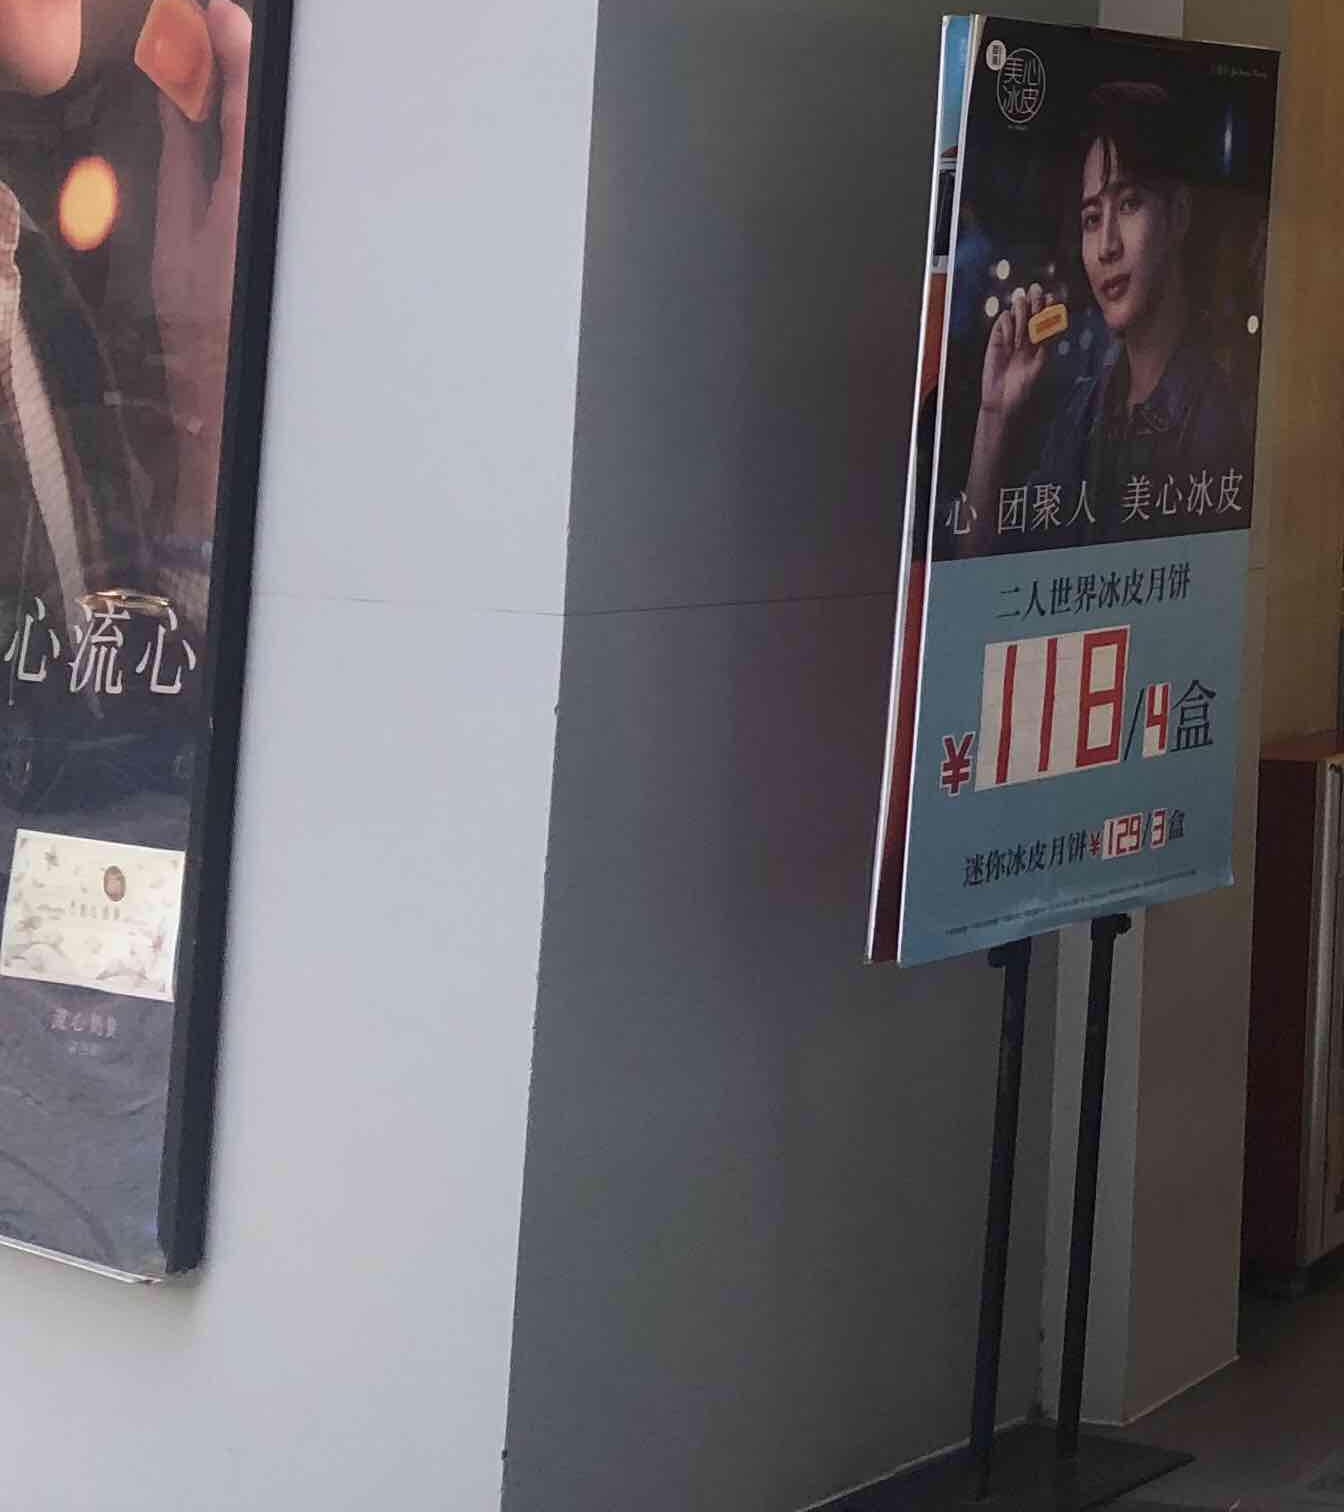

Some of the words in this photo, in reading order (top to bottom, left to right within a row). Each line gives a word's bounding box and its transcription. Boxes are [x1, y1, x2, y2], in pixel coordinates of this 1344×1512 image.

[945, 491, 978, 536] 心
[997, 480, 1098, 535] 团聚人
[1120, 467, 1245, 525] 美心冰皮
[994, 562, 1192, 620] 二人世界冰皮月饼
[3, 595, 197, 696] 心流心
